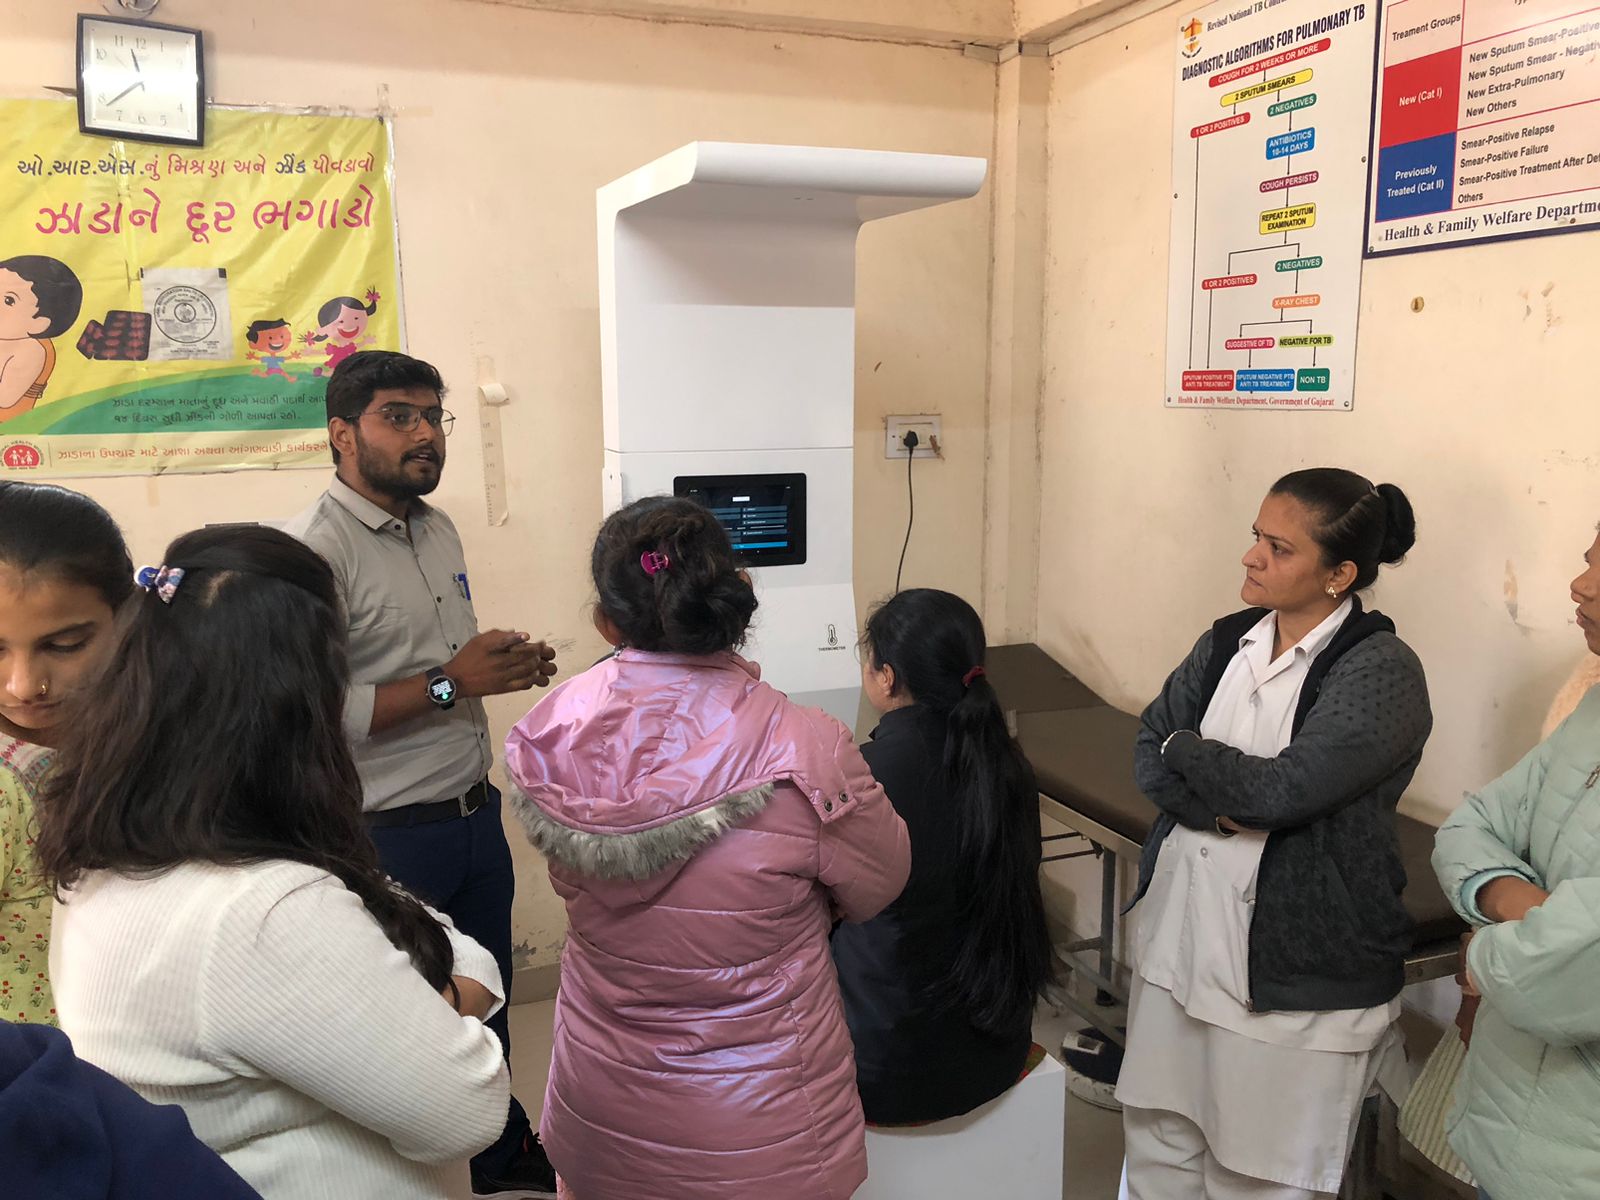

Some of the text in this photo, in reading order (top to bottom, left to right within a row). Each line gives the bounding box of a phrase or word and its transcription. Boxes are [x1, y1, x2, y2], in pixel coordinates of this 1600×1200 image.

[1254, 1, 1263, 13] TB
[1392, 13, 1461, 41] Treament Groups
[114, 35, 124, 46] 11
[135, 37, 146, 49] 12
[1181, 54, 1224, 81] DIAGNOSTIC
[1225, 35, 1275, 66] ALGORITHMS
[1276, 30, 1293, 49] FOR
[1295, 13, 1351, 43] PULMONARY
[1353, 3, 1365, 23] TB
[1469, 50, 1488, 63] New
[1490, 41, 1525, 58] Sputum
[1217, 44, 1319, 84] COUGH FOR 2 WEEKS OR MORE
[1468, 68, 1487, 82] New
[1489, 60, 1524, 76] Sputum
[1526, 52, 1558, 67] Smear
[1235, 75, 1296, 101] 2 SPUTUM SMEARS
[1467, 69, 1565, 100] New Extra-Pulmonary
[1269, 96, 1315, 115] 2 NEGATIVES
[1399, 87, 1443, 107] New (Cat I)
[1466, 98, 1517, 118] New Others
[1199, 124, 1208, 134] OR
[1208, 123, 1213, 132] 2
[1213, 115, 1245, 131] POSITIVES
[1269, 130, 1312, 148] ANTIBIOTICS
[1461, 123, 1555, 151] Smear-Positive Relapse
[1289, 141, 1309, 155] DAYS
[1460, 144, 1549, 168] Smear-Positive Failure
[233, 153, 266, 175] અને
[1395, 164, 1437, 181] Previously
[1459, 168, 1517, 186] Smear-Positive
[1519, 161, 1561, 176] Treatment
[1562, 157, 1585, 168] After
[1260, 172, 1317, 192] COUGH PERSISTS
[1387, 179, 1444, 198] Treated (Cat II)
[1458, 191, 1484, 204] Others
[35, 184, 375, 244] ઝાડાને દૂર ભગાડો
[1261, 210, 1284, 223] REPEAT
[1289, 206, 1314, 218] SPUTUM
[1267, 217, 1307, 231] EXAMINATION
[1385, 222, 1420, 241] Health
[1423, 222, 1433, 235] &
[1438, 216, 1479, 235] Family
[1482, 207, 1532, 227] Welfare
[1276, 258, 1320, 271] 2 NEGATIVES
[1208, 279, 1218, 288] OR
[1223, 275, 1254, 286] POSITIVES
[1274, 296, 1318, 307] X-RAY CHEST
[1279, 337, 1332, 347] NEGATIVE FOR TB
[1316, 376, 1326, 384] TB
